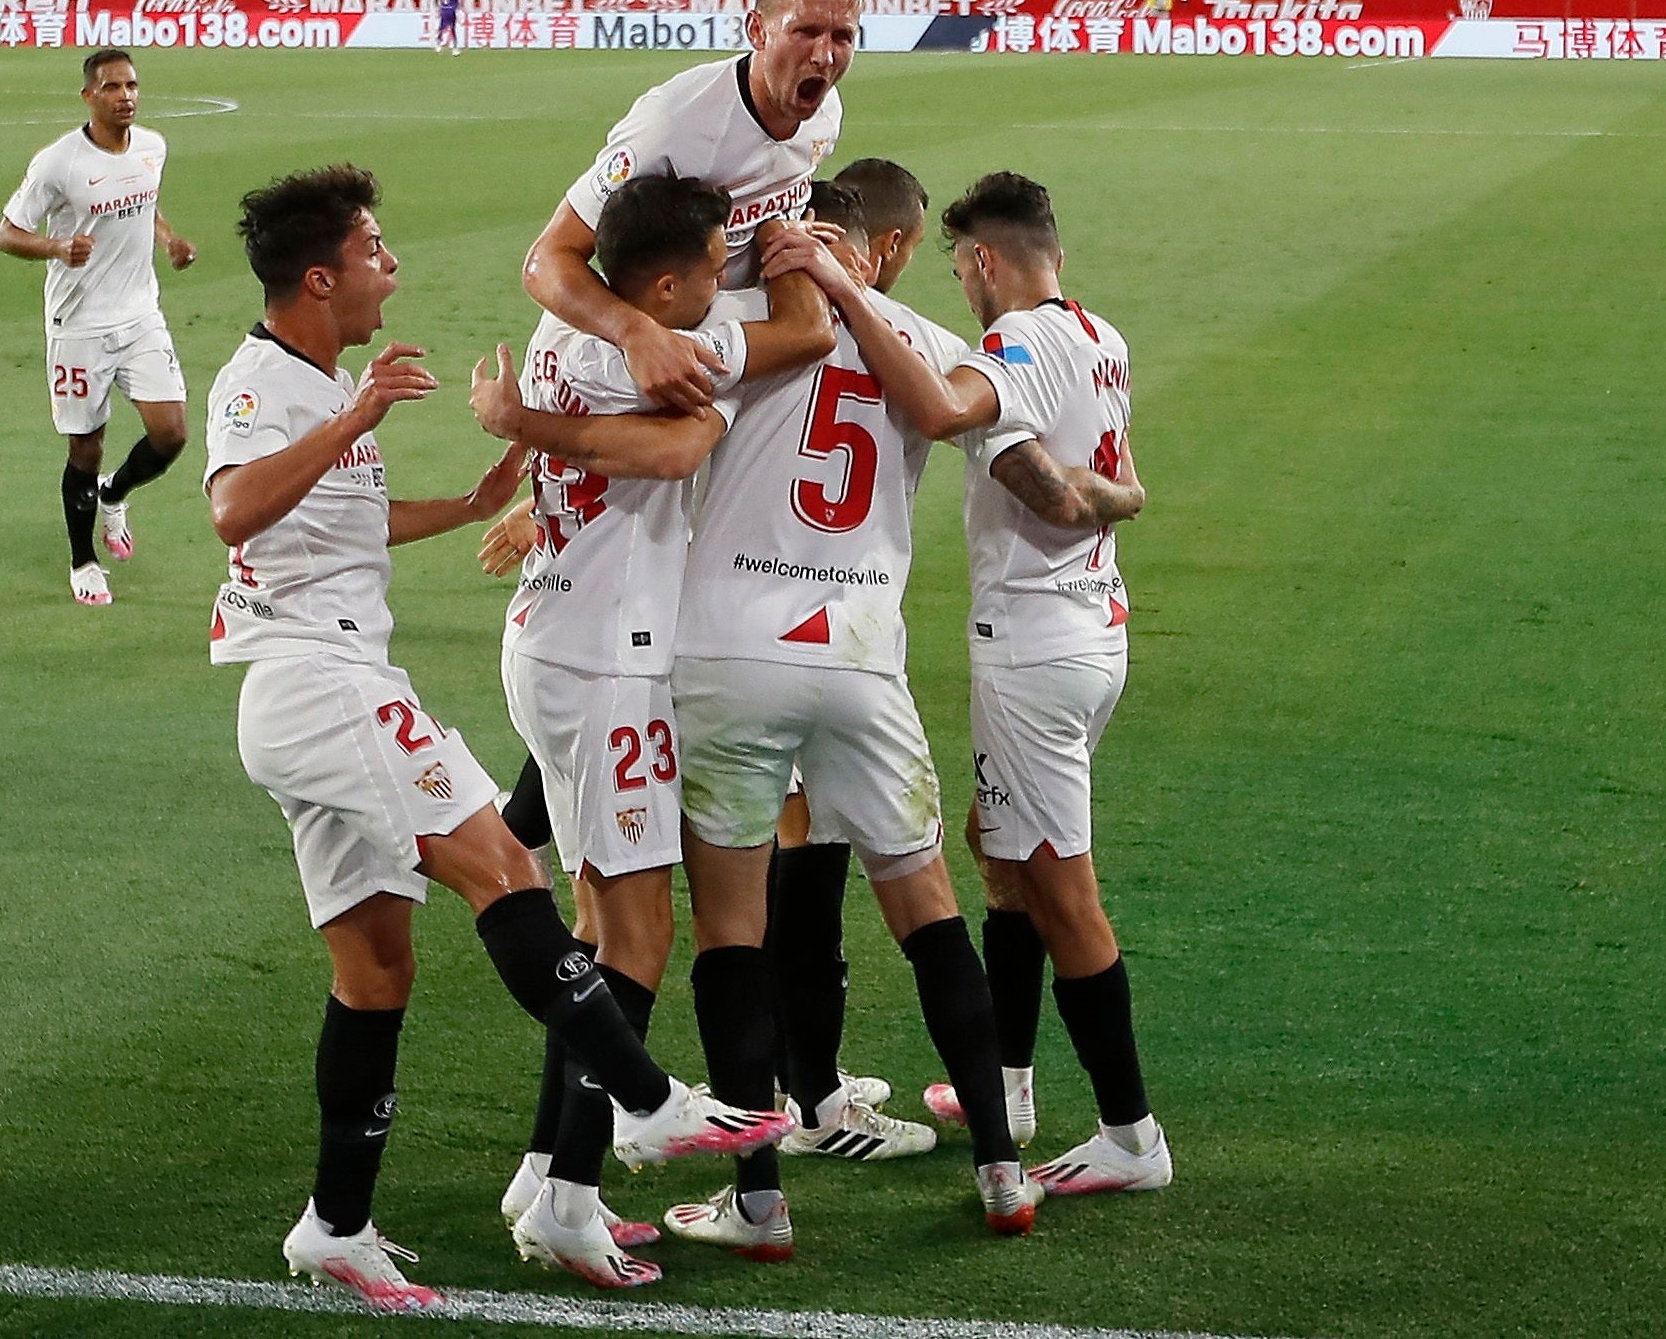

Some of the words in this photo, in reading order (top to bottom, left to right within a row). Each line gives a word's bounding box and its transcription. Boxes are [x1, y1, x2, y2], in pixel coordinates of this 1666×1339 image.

[75, 10, 341, 48] Mabo138.com
[1133, 16, 1425, 57] Mabo138.com
[90, 188, 159, 216] MARATHO
[118, 205, 144, 220] BET
[54, 364, 88, 399] 25
[790, 363, 883, 535] 5
[608, 719, 678, 795] 23
